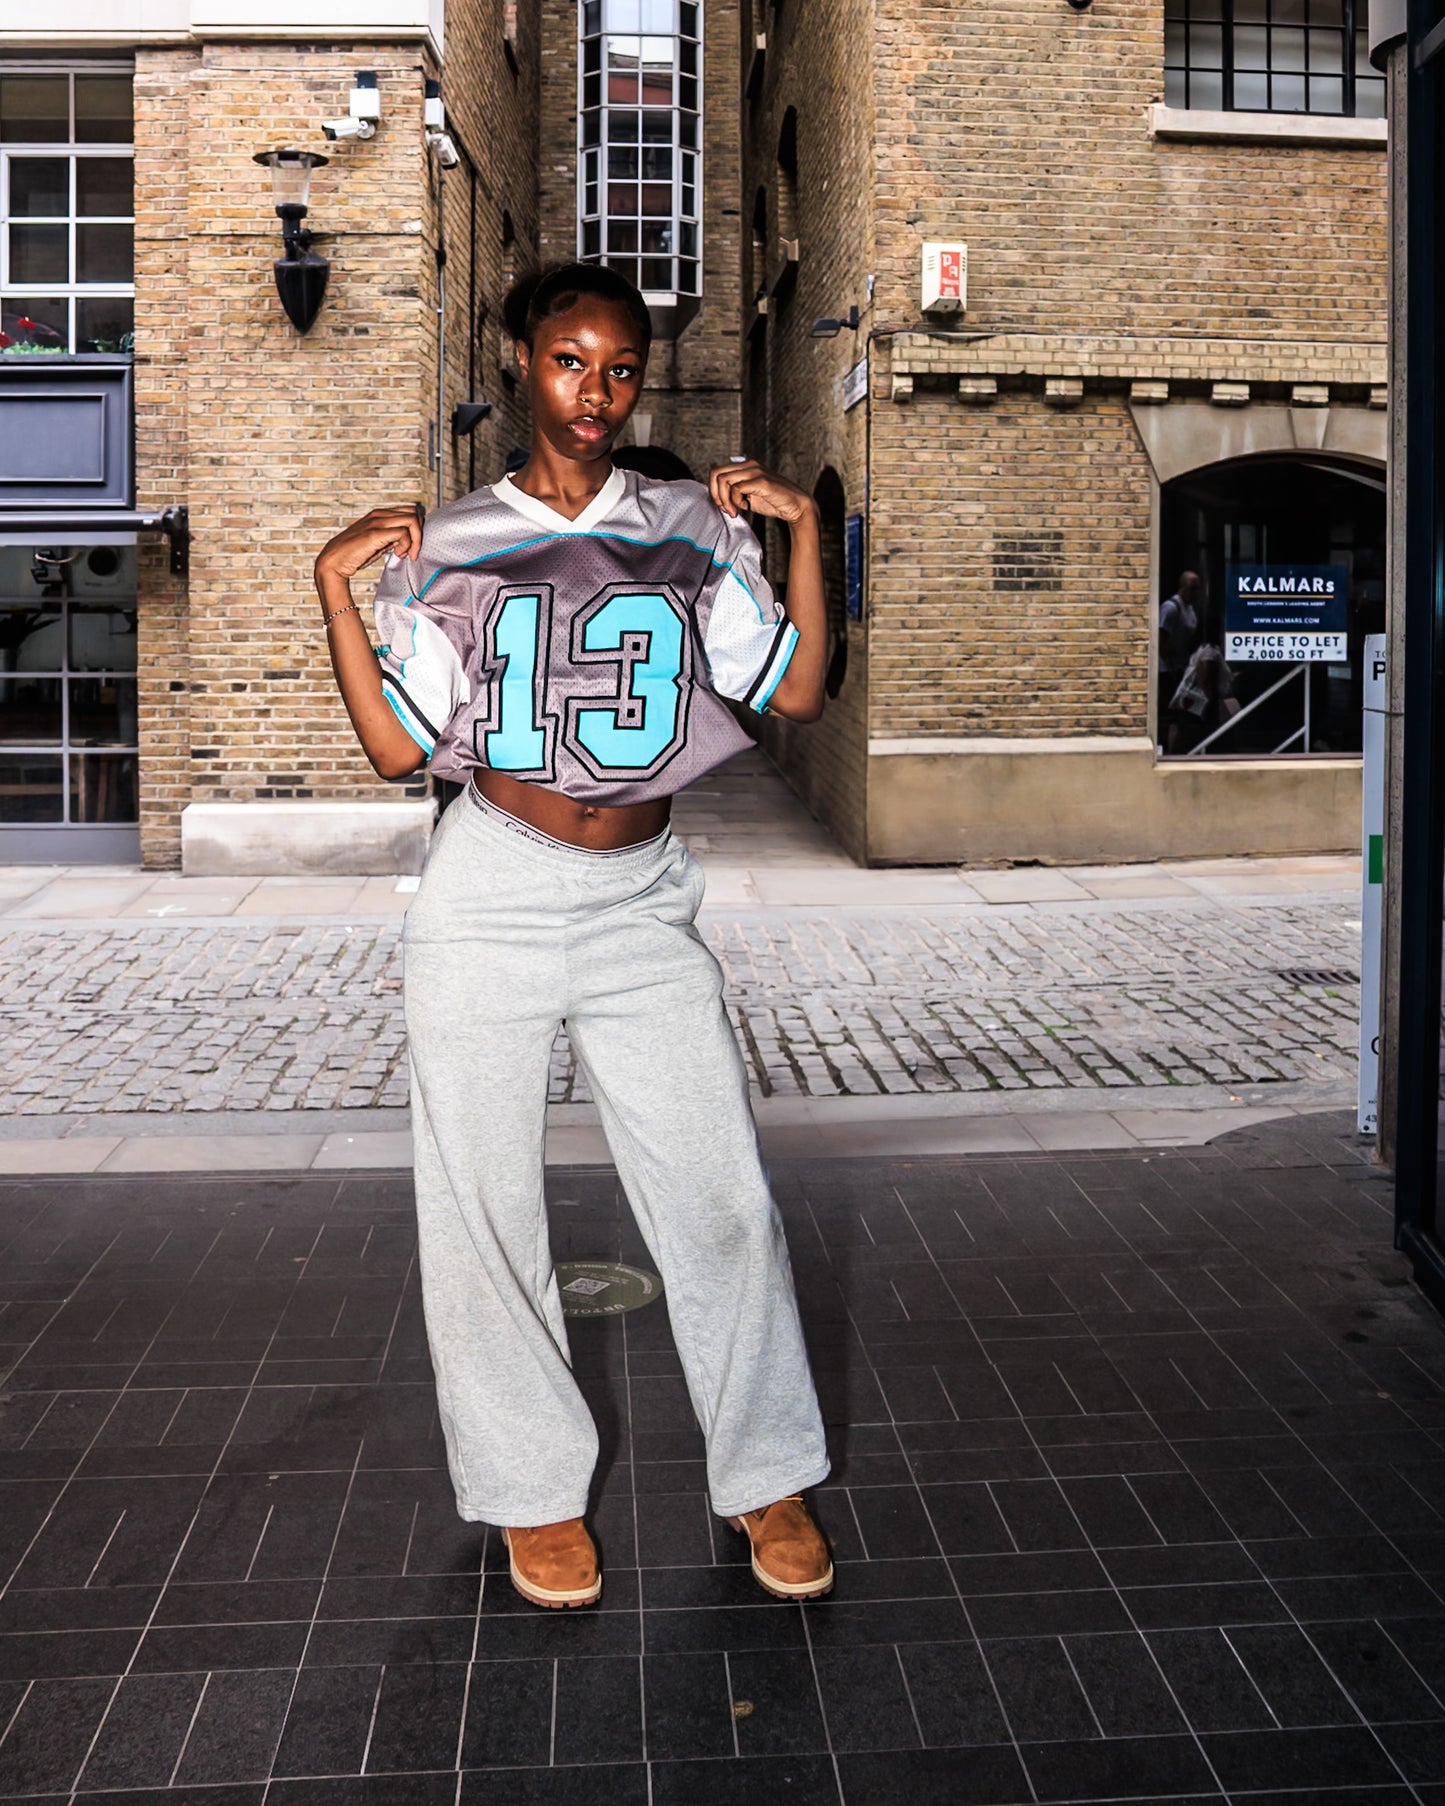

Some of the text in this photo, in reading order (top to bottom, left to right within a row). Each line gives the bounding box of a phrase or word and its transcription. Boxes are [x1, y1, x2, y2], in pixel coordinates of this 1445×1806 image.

[1232, 636, 1340, 648] OFFICE TO LET
[1248, 650, 1324, 661] 2,000 SQ FT
[474, 581, 694, 783] 13
